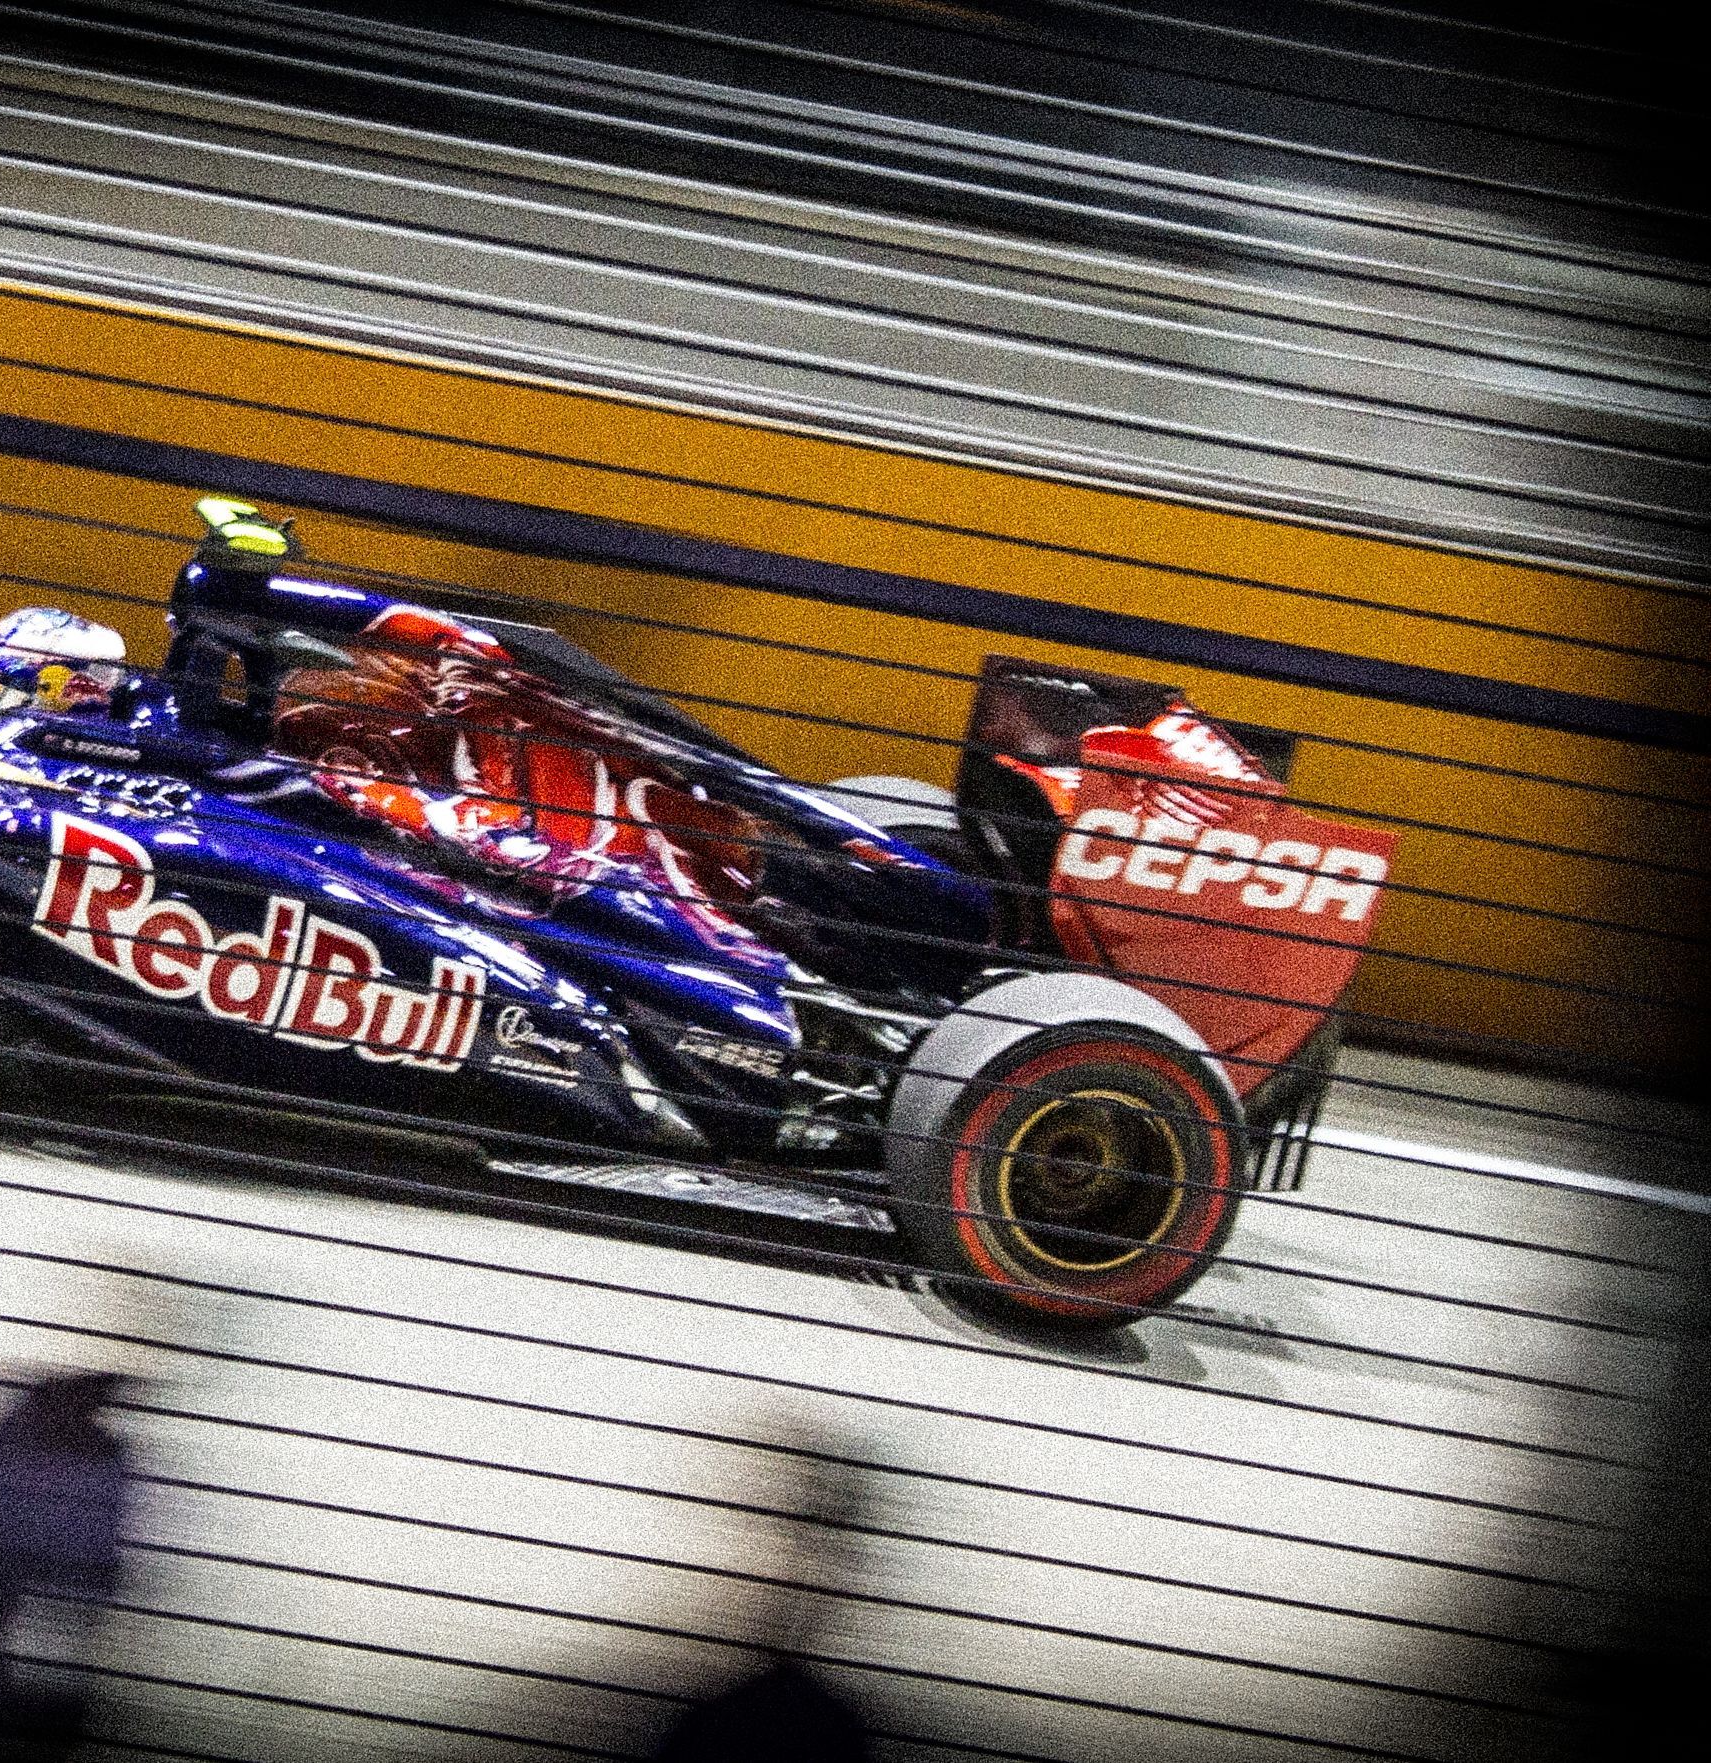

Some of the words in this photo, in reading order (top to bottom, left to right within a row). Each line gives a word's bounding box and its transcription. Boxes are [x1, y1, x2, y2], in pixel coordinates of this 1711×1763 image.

[31, 811, 304, 1032] Red
[275, 914, 487, 1073] Bull
[1056, 807, 1388, 922] CEPSA
